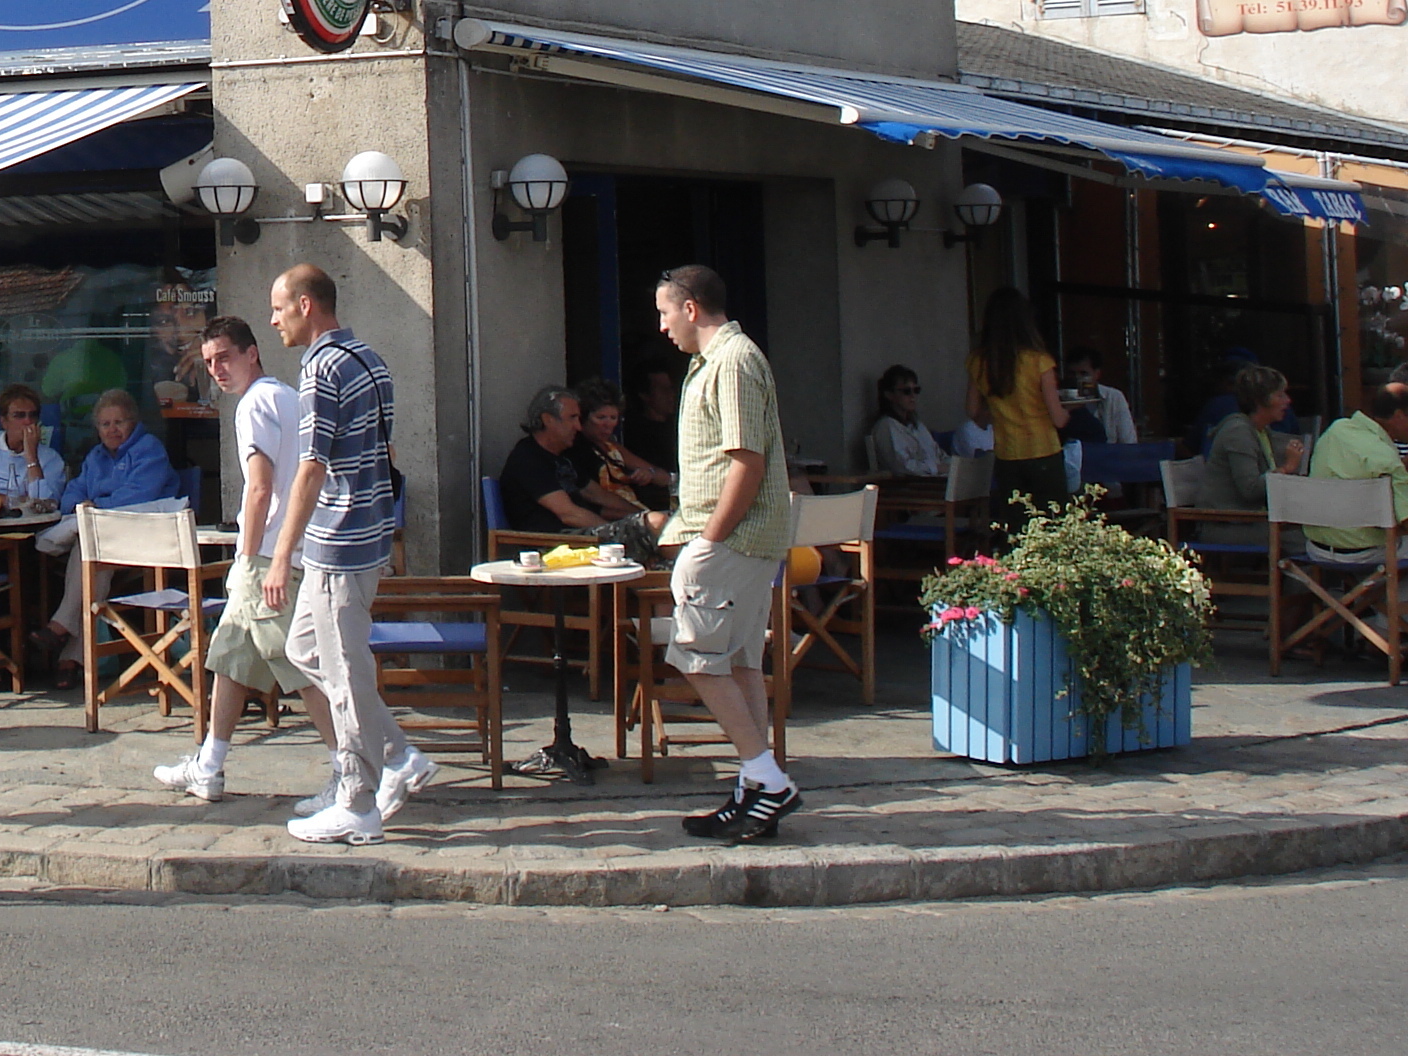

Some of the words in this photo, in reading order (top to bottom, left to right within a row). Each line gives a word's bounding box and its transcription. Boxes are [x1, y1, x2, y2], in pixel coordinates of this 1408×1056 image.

[1236, 1, 1268, 16] Tél:
[1311, 190, 1362, 220] TABAC
[156, 288, 176, 303] Café
